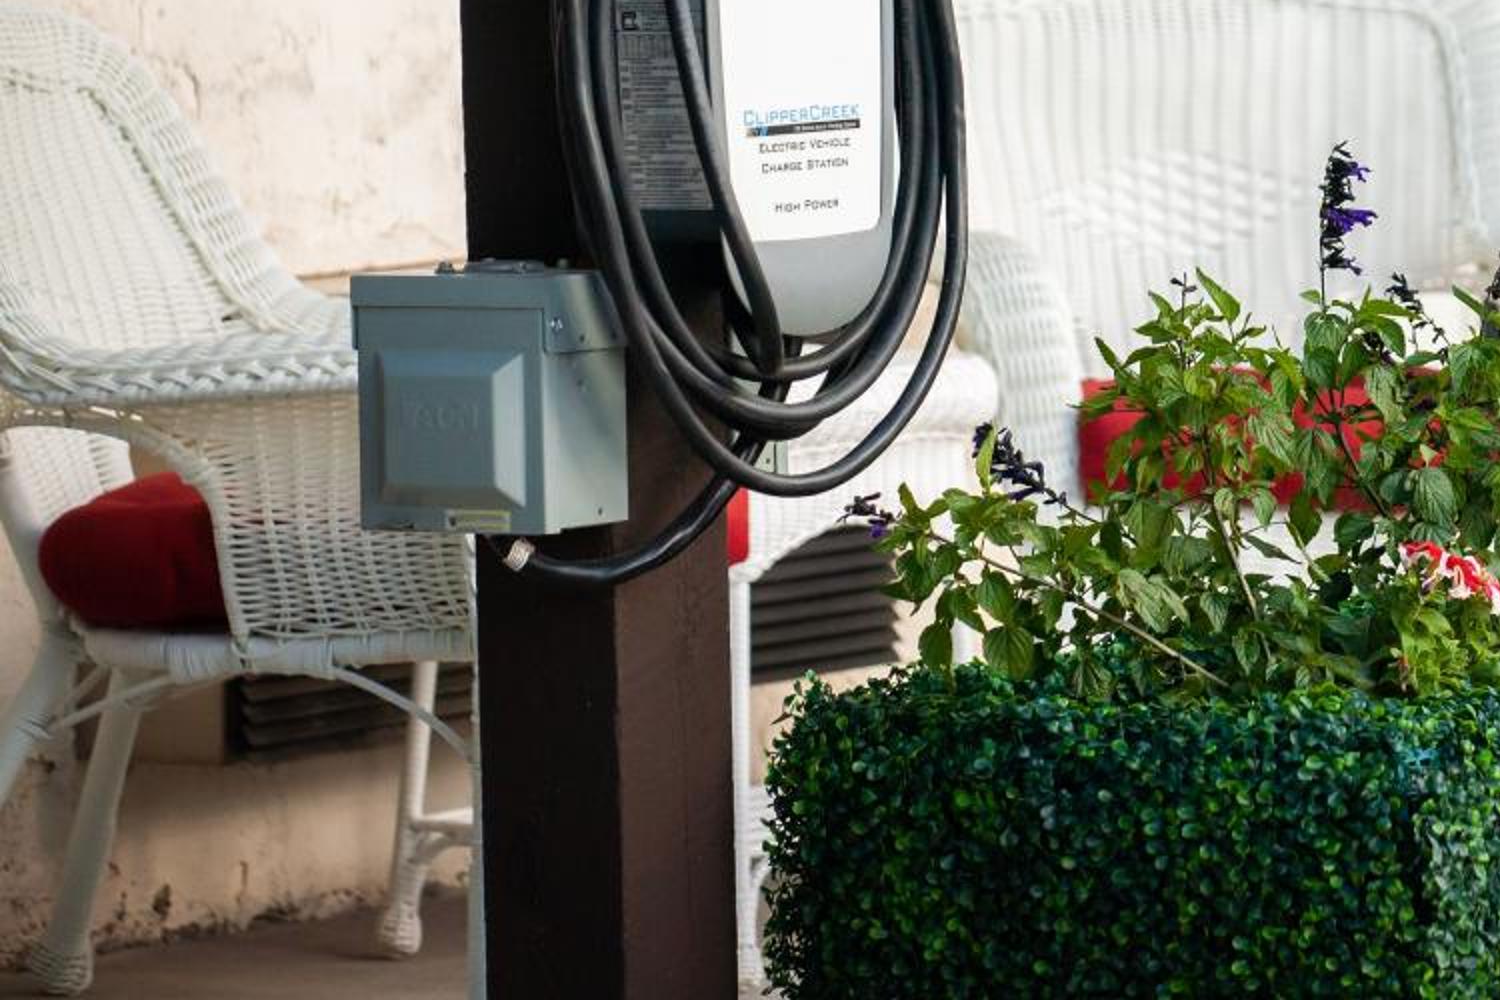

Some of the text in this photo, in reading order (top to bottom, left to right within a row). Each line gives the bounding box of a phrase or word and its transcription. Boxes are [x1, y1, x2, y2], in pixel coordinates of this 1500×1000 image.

[743, 103, 860, 126] CLIPPERCREEK
[759, 137, 851, 153] ELECTRIC VEHICLE
[761, 157, 849, 174] CHARGE STATION
[775, 199, 839, 213] HIGH POWER
